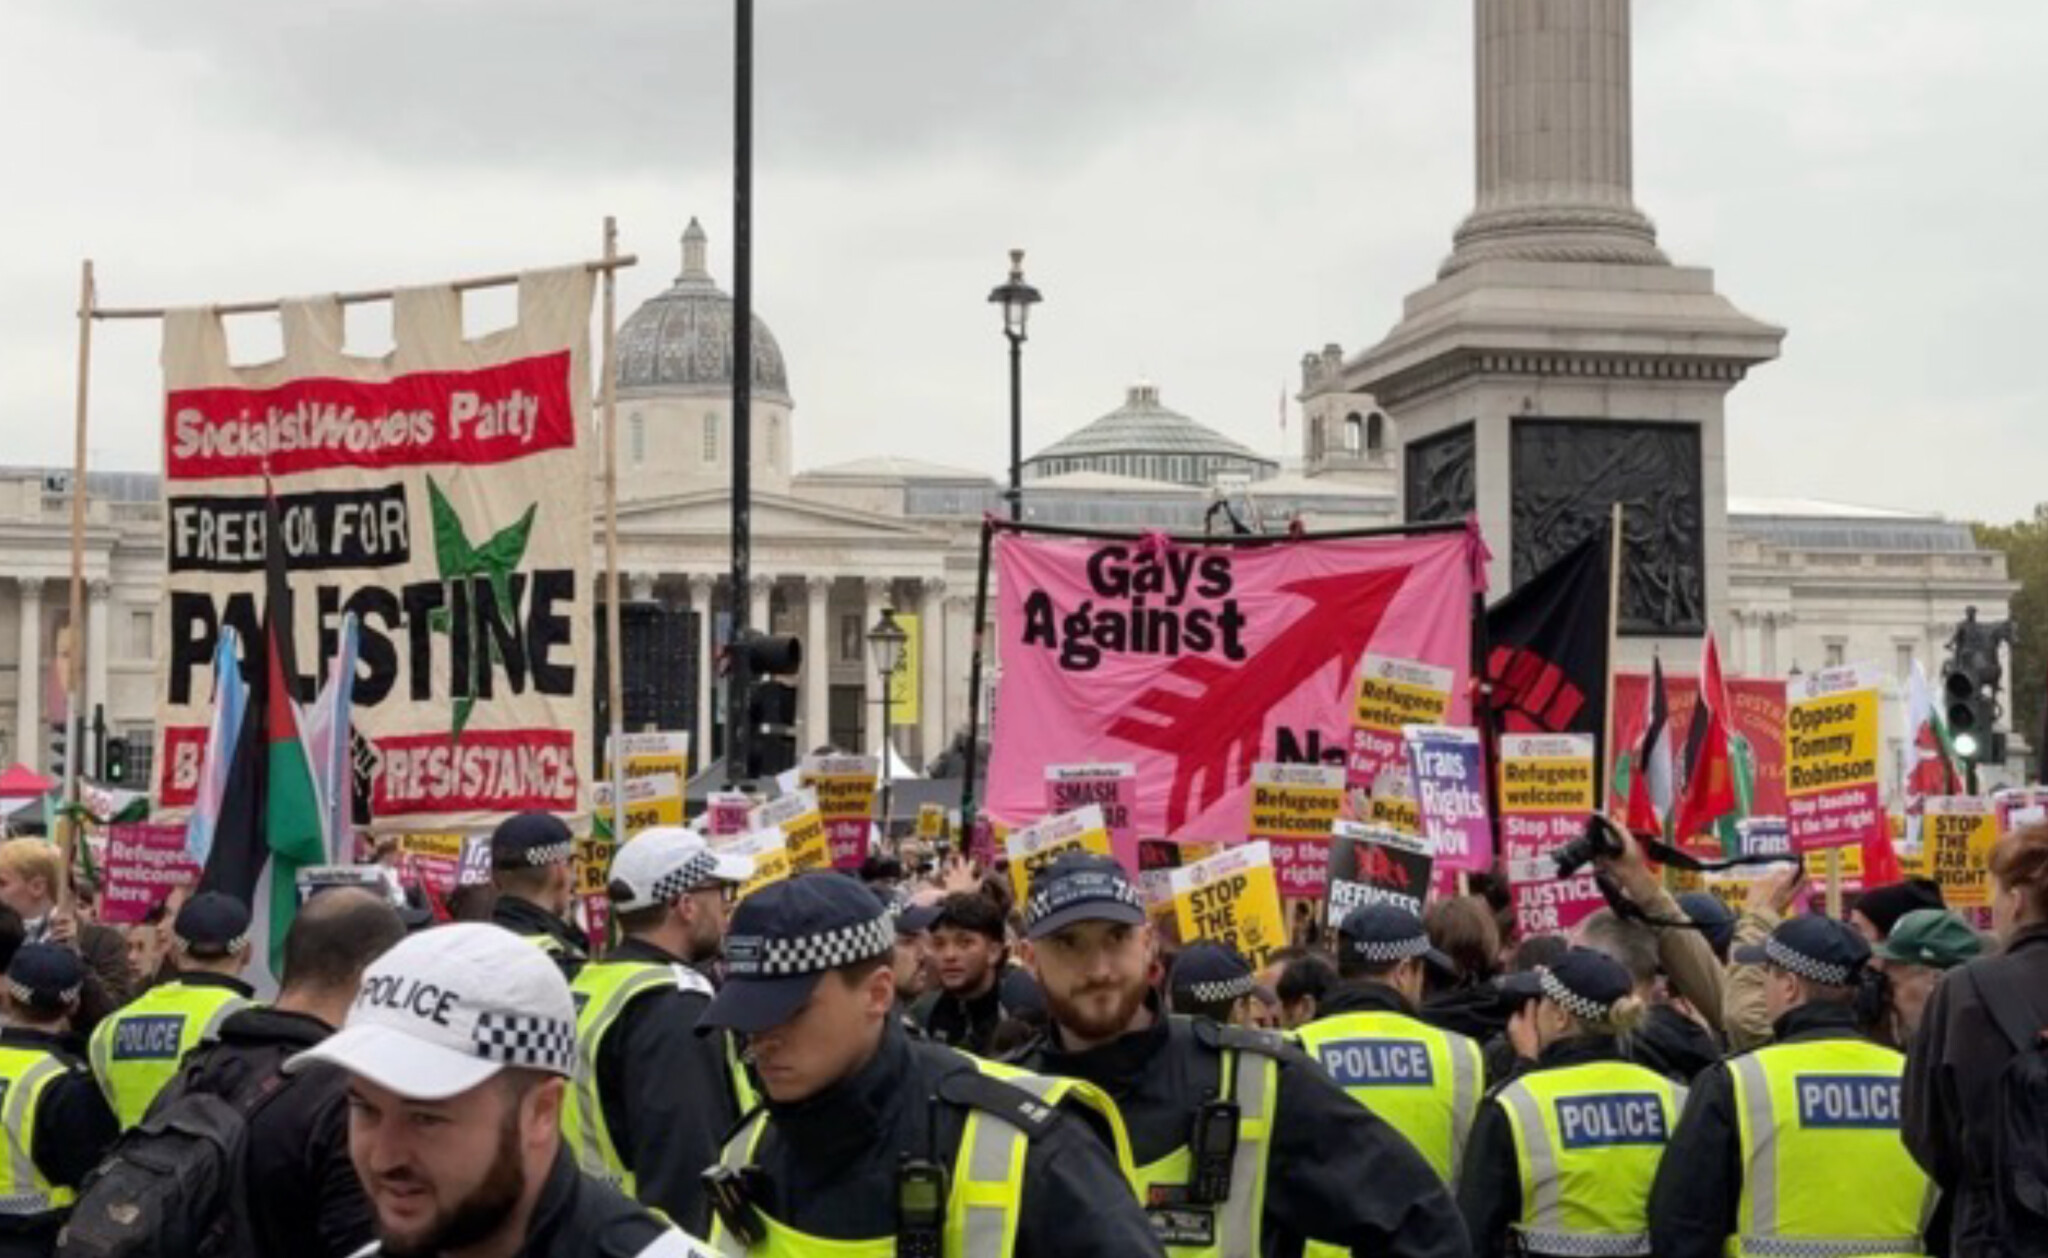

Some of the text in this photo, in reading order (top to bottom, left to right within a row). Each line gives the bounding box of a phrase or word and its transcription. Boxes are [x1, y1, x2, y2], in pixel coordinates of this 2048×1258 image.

[450, 389, 538, 443] Party
[331, 501, 407, 557] FOR
[1087, 546, 1233, 605] Gays
[1022, 590, 1247, 671] Against
[1790, 703, 1857, 732] Oppose
[1790, 732, 1854, 759] Tommy
[1409, 743, 1467, 780] Trans
[1505, 763, 1588, 786] Refugees
[1790, 759, 1875, 789] Robinson
[1256, 788, 1339, 813] Refugees
[1420, 778, 1483, 825] Rights
[1506, 785, 1585, 804] welcome
[1507, 817, 1547, 840] Stop
[1936, 816, 1983, 833] STOP
[1936, 835, 1969, 849] THE
[1935, 853, 1968, 868] FAR
[1190, 875, 1248, 914] STOP
[1517, 906, 1558, 932] FOR
[359, 975, 459, 1027] POLICE
[1324, 1045, 1428, 1080] POLICE
[1561, 1101, 1663, 1140] POLICE
